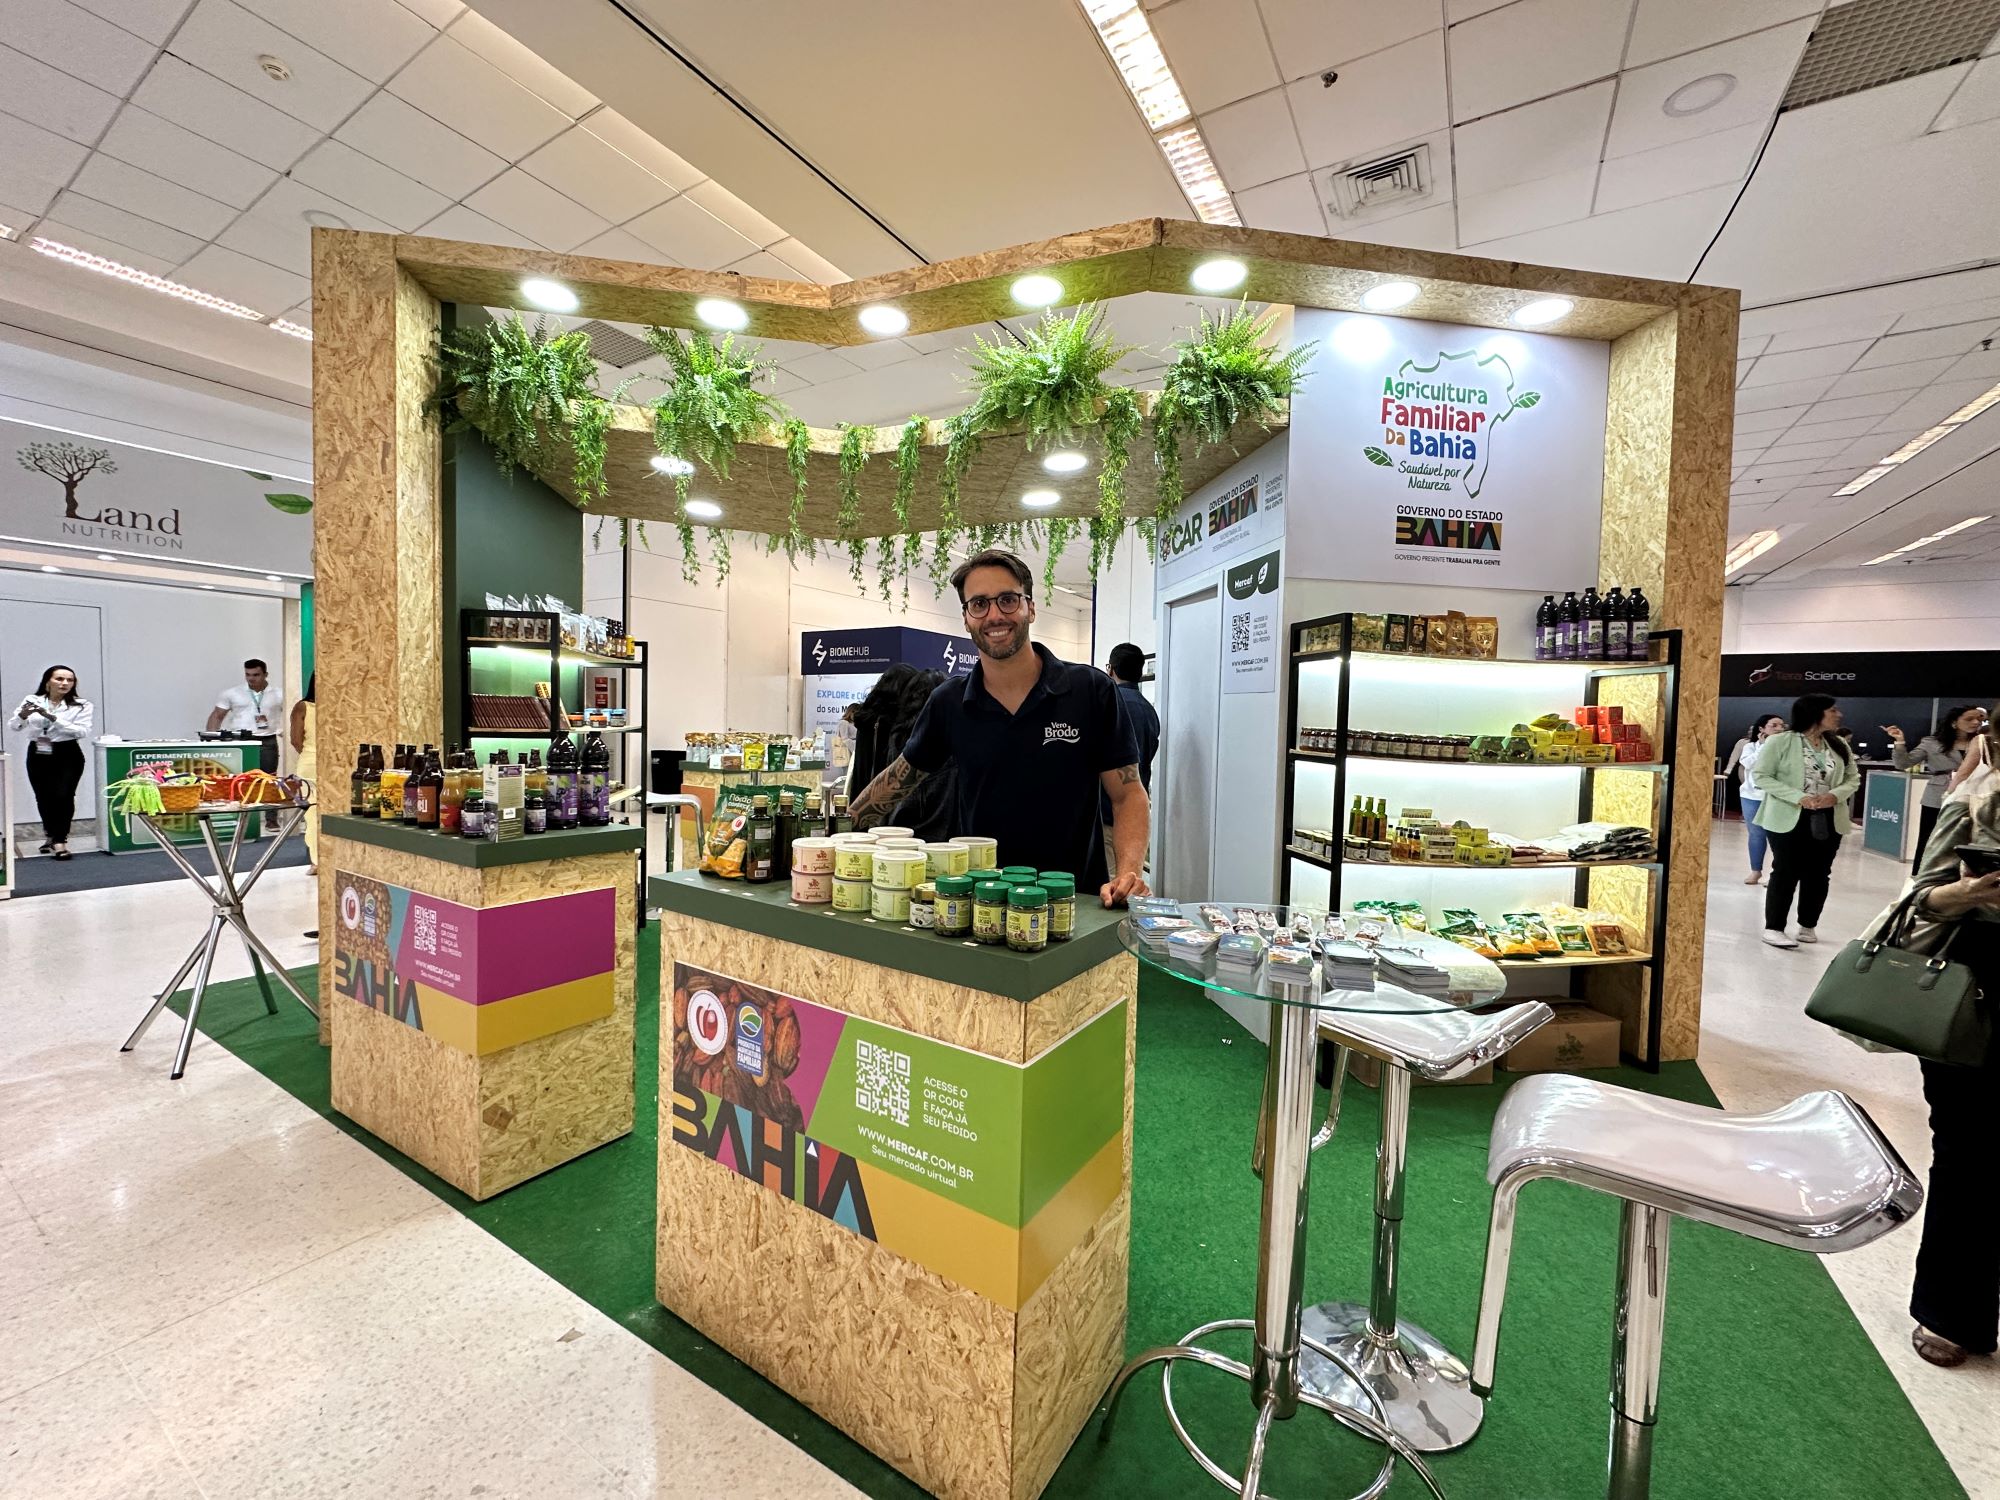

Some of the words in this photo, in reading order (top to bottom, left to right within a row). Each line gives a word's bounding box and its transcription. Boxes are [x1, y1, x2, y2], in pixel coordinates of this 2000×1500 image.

[1383, 377, 1488, 405] Agricultura
[1381, 397, 1486, 433] Familiar
[1385, 427, 1406, 446] Da
[1409, 429, 1476, 460] Bahia
[1398, 460, 1443, 478] Saudável
[1443, 468, 1461, 479] por
[1209, 492, 1231, 510] GOVERNO
[1231, 486, 1238, 498] DO
[1239, 474, 1258, 493] ESTADO
[1407, 477, 1452, 491] Natureza
[1209, 486, 1258, 537] BAHIA
[1397, 504, 1446, 518] GOVERNO
[1448, 509, 1462, 518] DO
[1465, 510, 1503, 521] ESTADO
[62, 522, 183, 550] NUTRITION
[1172, 512, 1202, 555] CAR
[1396, 515, 1502, 550] BAHIA
[829, 646, 870, 657] BIOMEHUB
[958, 653, 979, 665] BIOME
[1804, 671, 1856, 681] Science
[816, 690, 850, 700] EXPLORE
[816, 704, 826, 713] do
[827, 706, 840, 714] seu
[1044, 726, 1079, 738] Brodo
[1051, 721, 1067, 729] Vero
[335, 949, 424, 1032] BAHIA
[737, 1052, 761, 1071] FAMILIAR
[923, 1076, 959, 1096] ACESSE
[960, 1088, 968, 1099] O
[923, 1088, 937, 1101] QR
[939, 1094, 965, 1111] CODE
[923, 1101, 929, 1111] E
[930, 1104, 954, 1120] FAÇA
[955, 1112, 968, 1126] JÁ
[923, 1114, 940, 1128] SEU
[942, 1121, 978, 1142] PEDIDO
[672, 1085, 878, 1243] BAHIA
[858, 1124, 974, 1182] WWW.MERCAF.COM.BR
[872, 1144, 887, 1159] Seu
[888, 1153, 926, 1175] mercado
[927, 1169, 958, 1188] virtual
